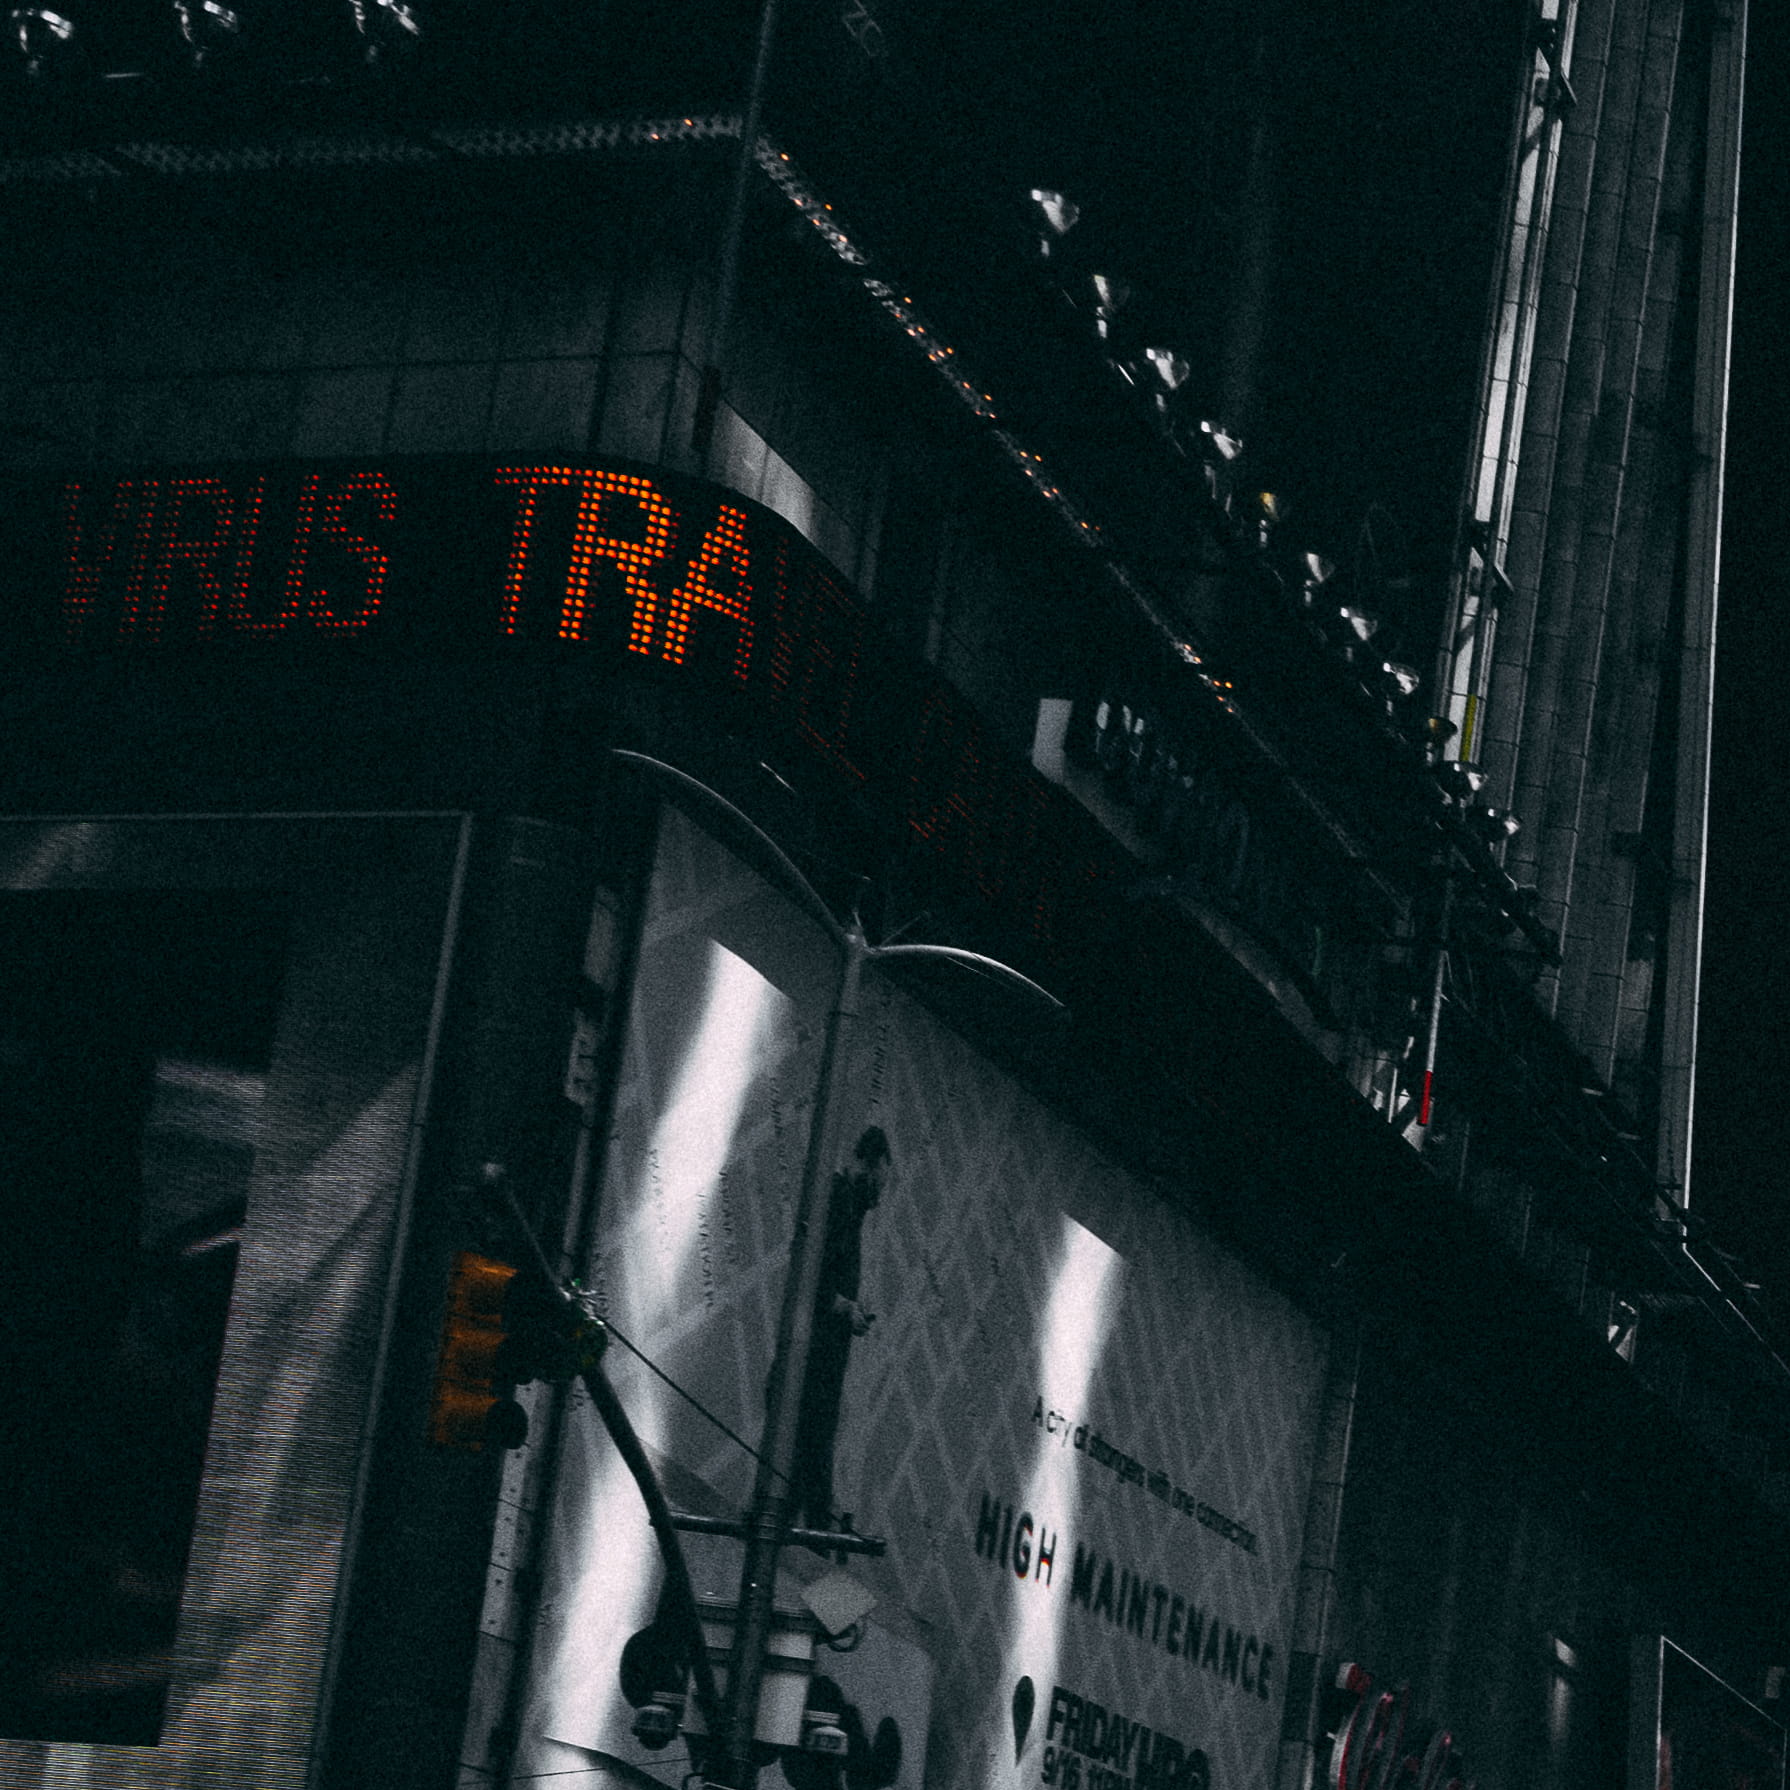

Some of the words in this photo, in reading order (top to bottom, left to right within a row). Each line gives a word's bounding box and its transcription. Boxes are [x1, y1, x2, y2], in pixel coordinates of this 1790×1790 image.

[978, 1497, 1056, 1588] HIGH
[1072, 1542, 1275, 1702] MAINTENANCE
[1046, 1686, 1140, 1771] FRIDAY
